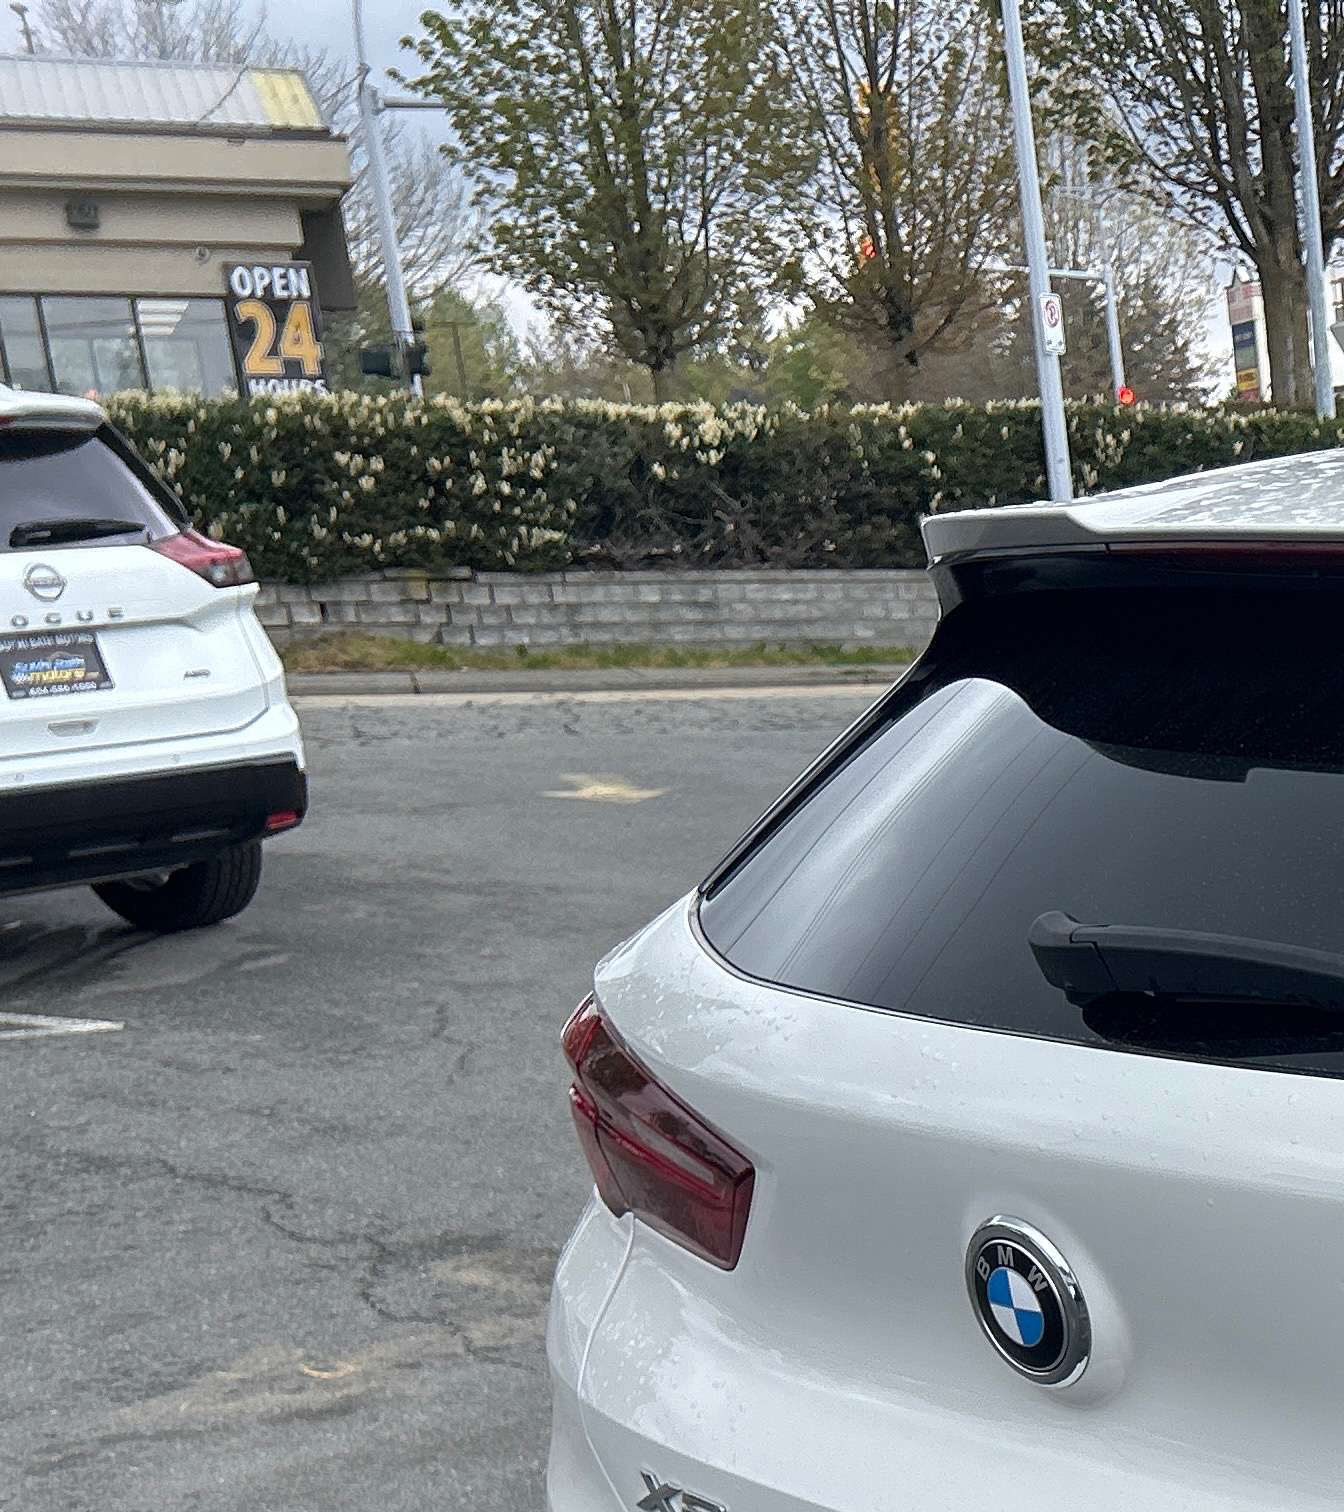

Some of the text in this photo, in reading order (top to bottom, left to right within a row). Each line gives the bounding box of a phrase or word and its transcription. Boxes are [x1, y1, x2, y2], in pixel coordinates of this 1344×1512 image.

[230, 265, 312, 299] OPEN
[234, 299, 324, 376] 24
[976, 1245, 1049, 1293] BMW
